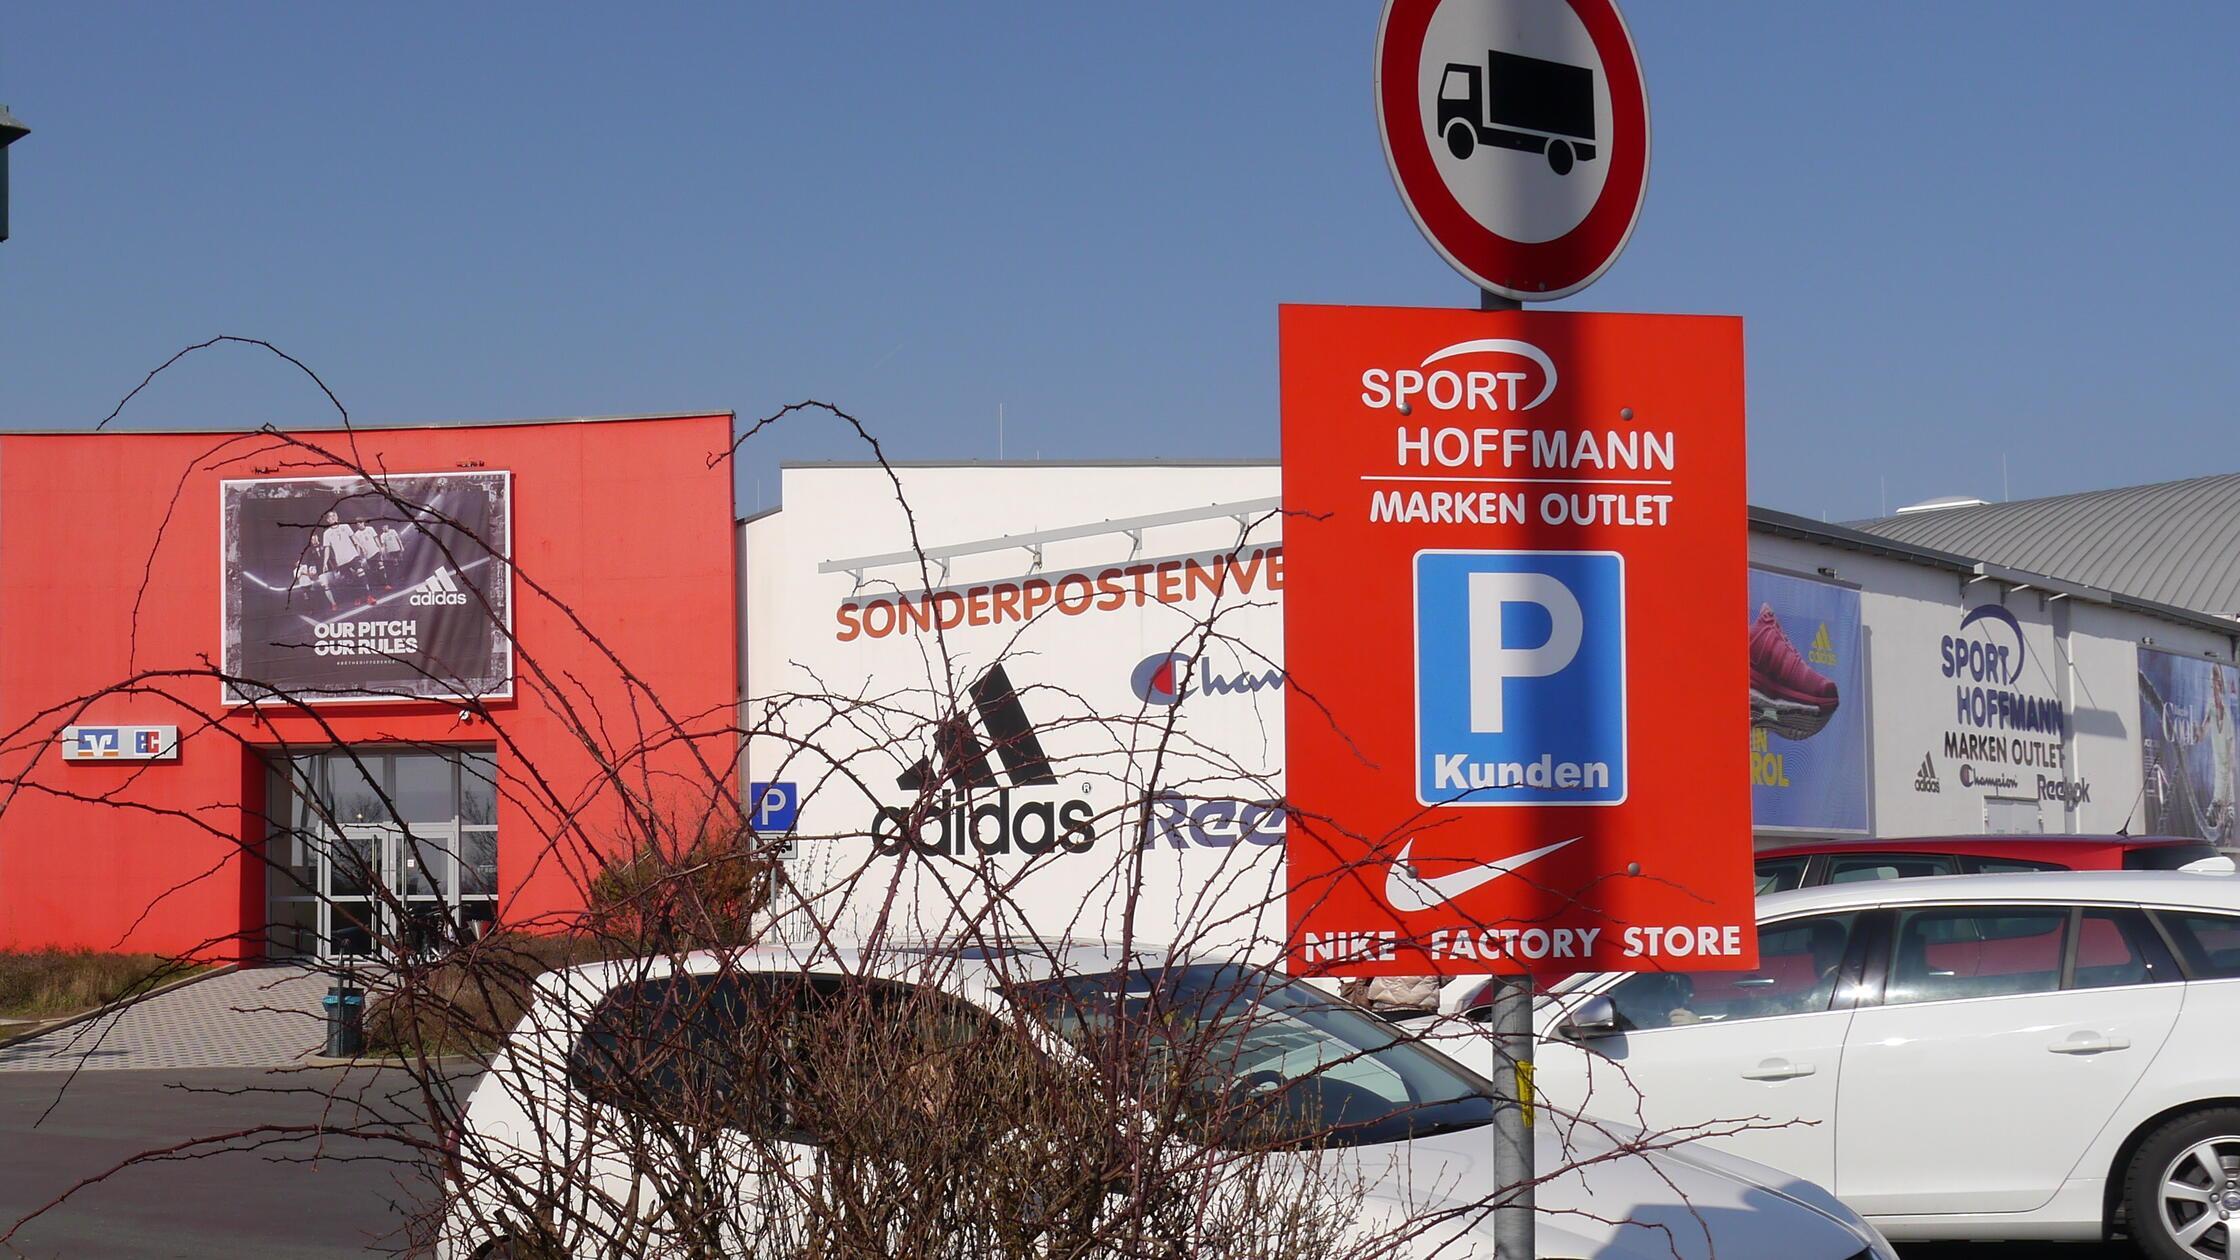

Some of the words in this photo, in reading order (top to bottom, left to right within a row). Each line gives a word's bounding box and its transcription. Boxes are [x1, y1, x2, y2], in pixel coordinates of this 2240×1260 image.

[1361, 368, 1527, 411] SPORT
[1397, 427, 1674, 471] HOFFMANN
[1369, 490, 1525, 525] MARKEN
[1540, 493, 1674, 527] OUTLET
[410, 590, 467, 606] adidas
[314, 622, 355, 639] OUR
[358, 620, 416, 637] PITCH
[314, 639, 355, 656] OUR
[358, 637, 418, 655] RULES
[1468, 572, 1584, 733] P
[1941, 635, 2009, 686] SPORT
[1956, 685, 2064, 738] HOFFMANN
[1944, 731, 2008, 763] MARKEN
[2011, 739, 2065, 769] OUTLET
[1434, 753, 1609, 789] Kunden
[1914, 778, 1941, 793] adidas
[1960, 764, 2018, 797] Champion
[762, 788, 786, 825] P
[871, 787, 1096, 857] adidas
[1305, 931, 1396, 962] NIKE
[1431, 927, 1600, 961] FACTORY
[1623, 925, 1741, 957] STORE
